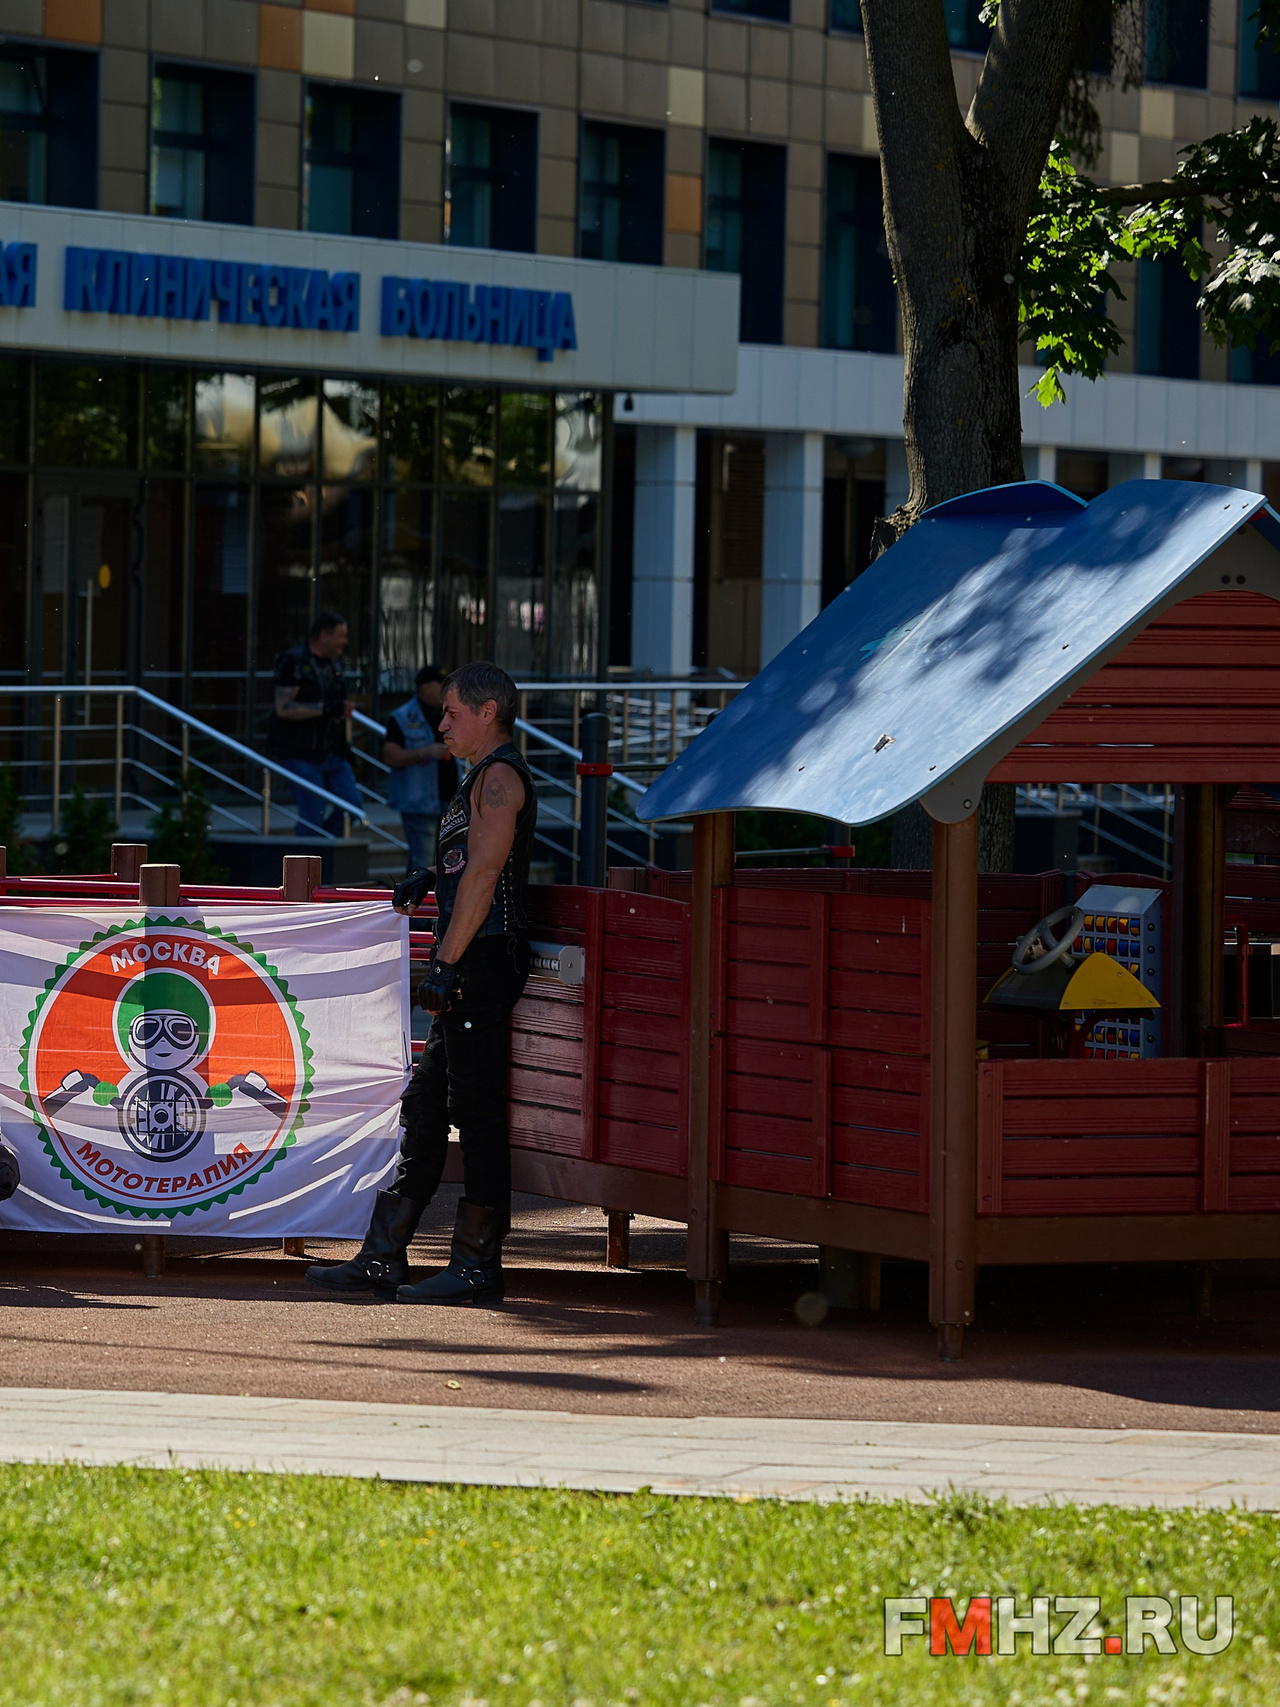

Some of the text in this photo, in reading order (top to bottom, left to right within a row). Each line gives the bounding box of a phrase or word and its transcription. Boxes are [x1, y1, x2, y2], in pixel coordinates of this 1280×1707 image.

[64, 245, 360, 333] КЛИНИЧЕСКАЯ
[380, 275, 578, 362] БОЛЬНИЦА
[110, 941, 221, 976] МОСКВА
[76, 1141, 253, 1193] МОТОТЕРАПИЯ
